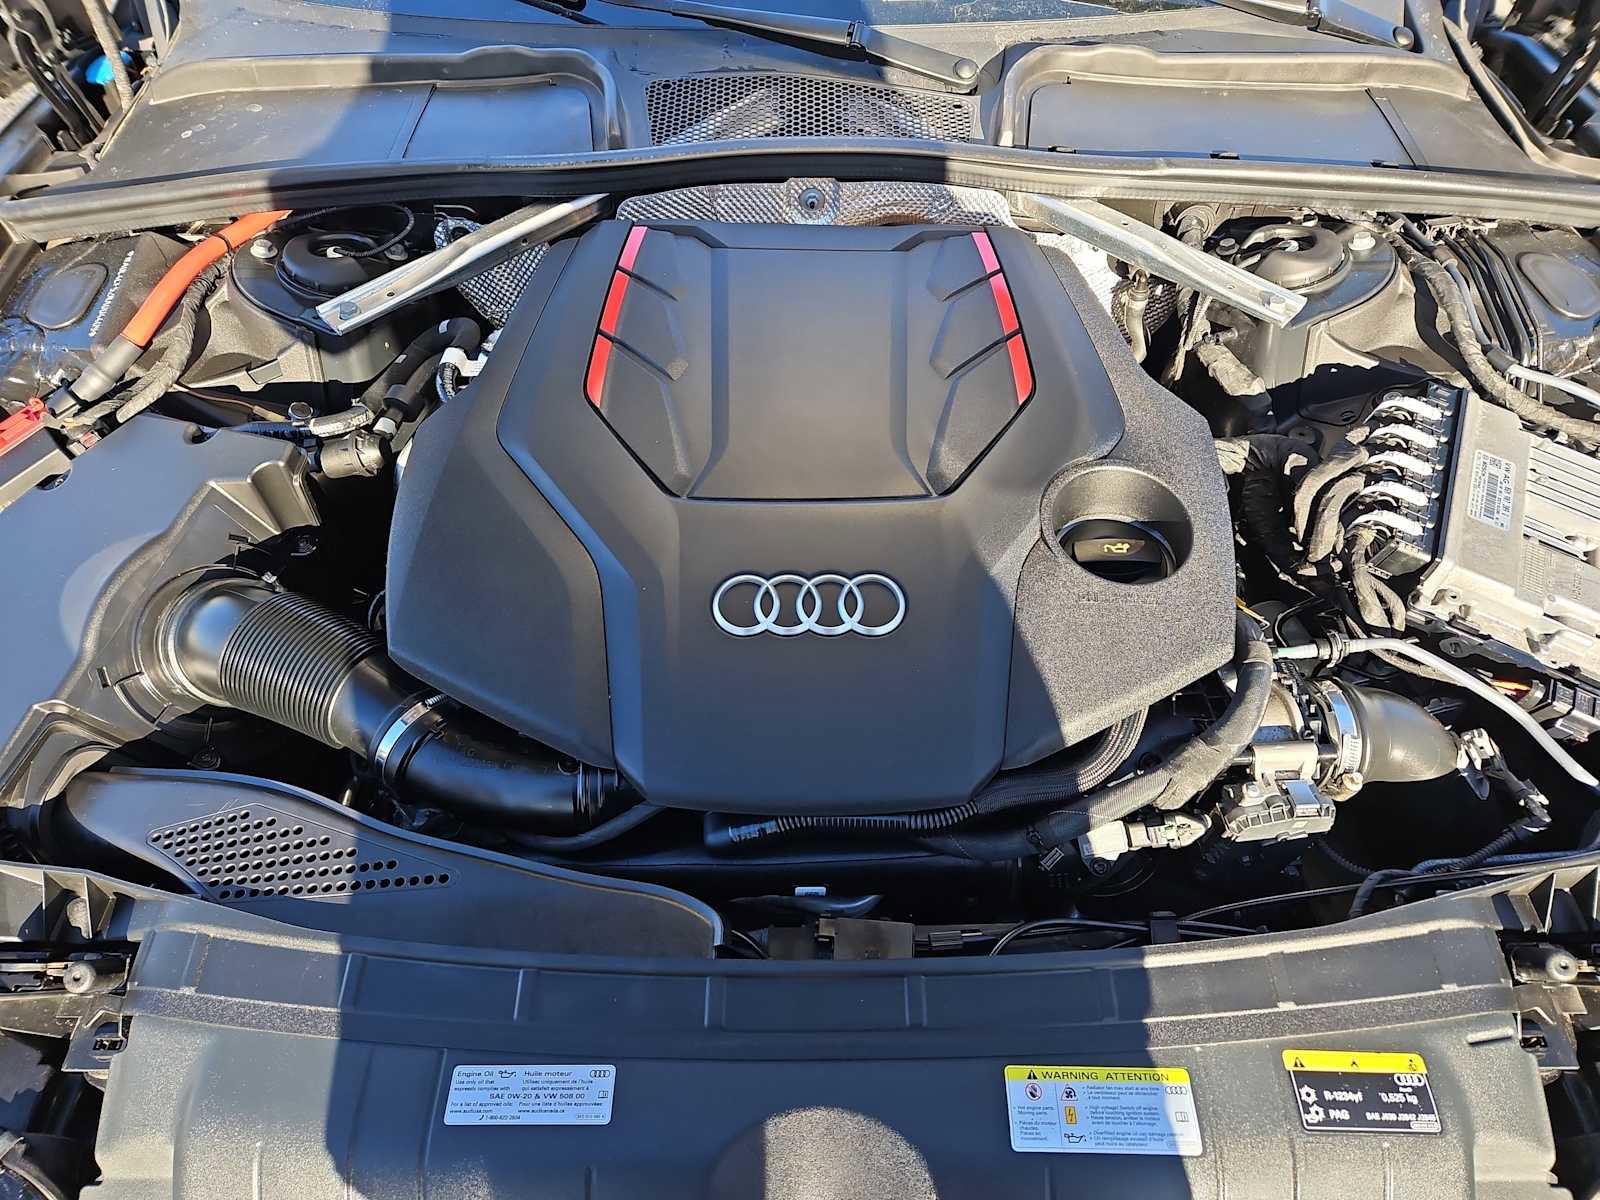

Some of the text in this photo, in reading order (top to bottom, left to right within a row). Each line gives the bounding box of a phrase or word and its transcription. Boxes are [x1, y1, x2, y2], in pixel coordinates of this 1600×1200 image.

[1041, 1071, 1169, 1081] WARNING ATTENTION
[1406, 1092, 1418, 1105] kg
[1328, 1109, 1350, 1120] PAG
